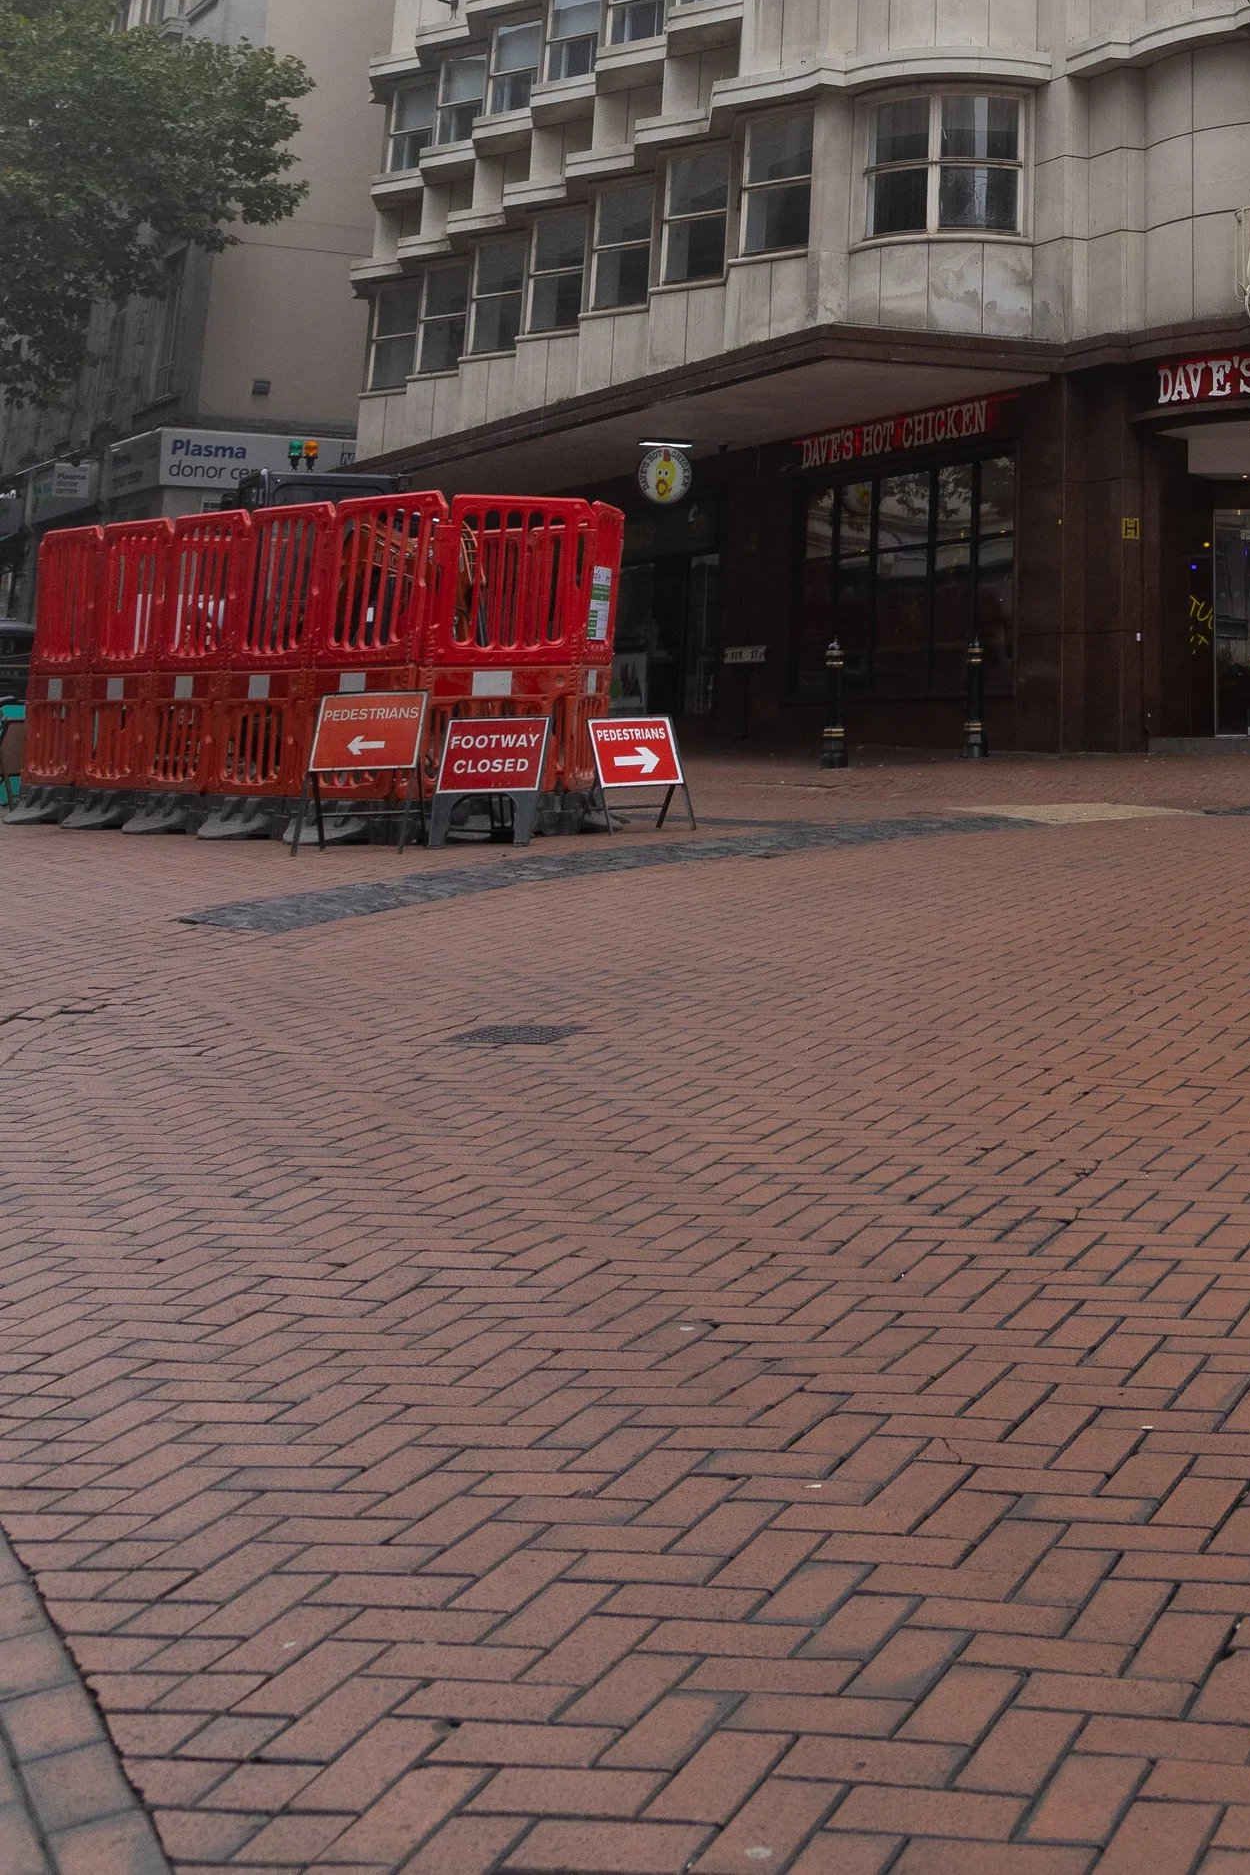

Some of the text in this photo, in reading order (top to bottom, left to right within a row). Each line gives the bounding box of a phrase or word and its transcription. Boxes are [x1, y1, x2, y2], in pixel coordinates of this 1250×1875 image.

[802, 399, 988, 470] DAVE'S HOT CHICKEN
[170, 438, 247, 460] Plasma
[168, 460, 226, 480] donor
[647, 449, 664, 463] HOT
[671, 450, 691, 489] CHICKEN
[323, 706, 420, 723] PEDESTRIANS
[449, 732, 541, 750] FOOTWAY
[596, 728, 667, 742] PEDESTRIANS
[453, 757, 530, 775] CLOSED
